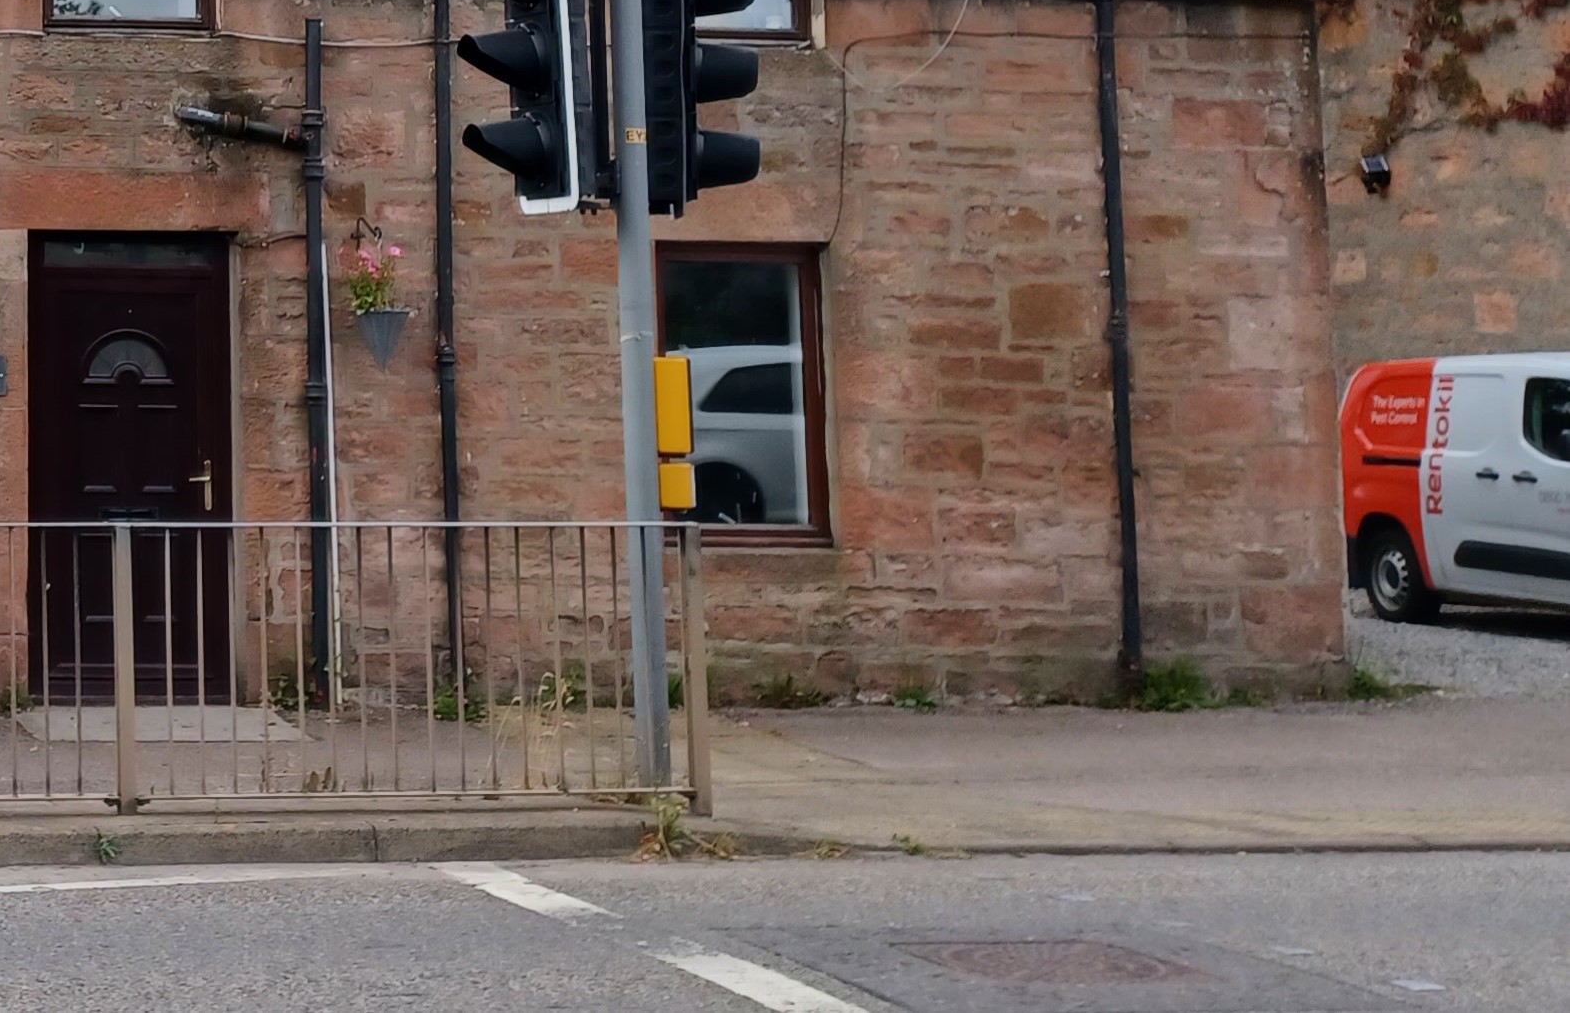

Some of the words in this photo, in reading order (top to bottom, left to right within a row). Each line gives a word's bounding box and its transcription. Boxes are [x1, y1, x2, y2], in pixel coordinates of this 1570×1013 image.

[1372, 394, 1386, 409] The
[1388, 394, 1416, 411] Experts
[1371, 411, 1387, 425] Pest
[1387, 410, 1418, 425] Control
[1426, 376, 1455, 515] Rentokil
